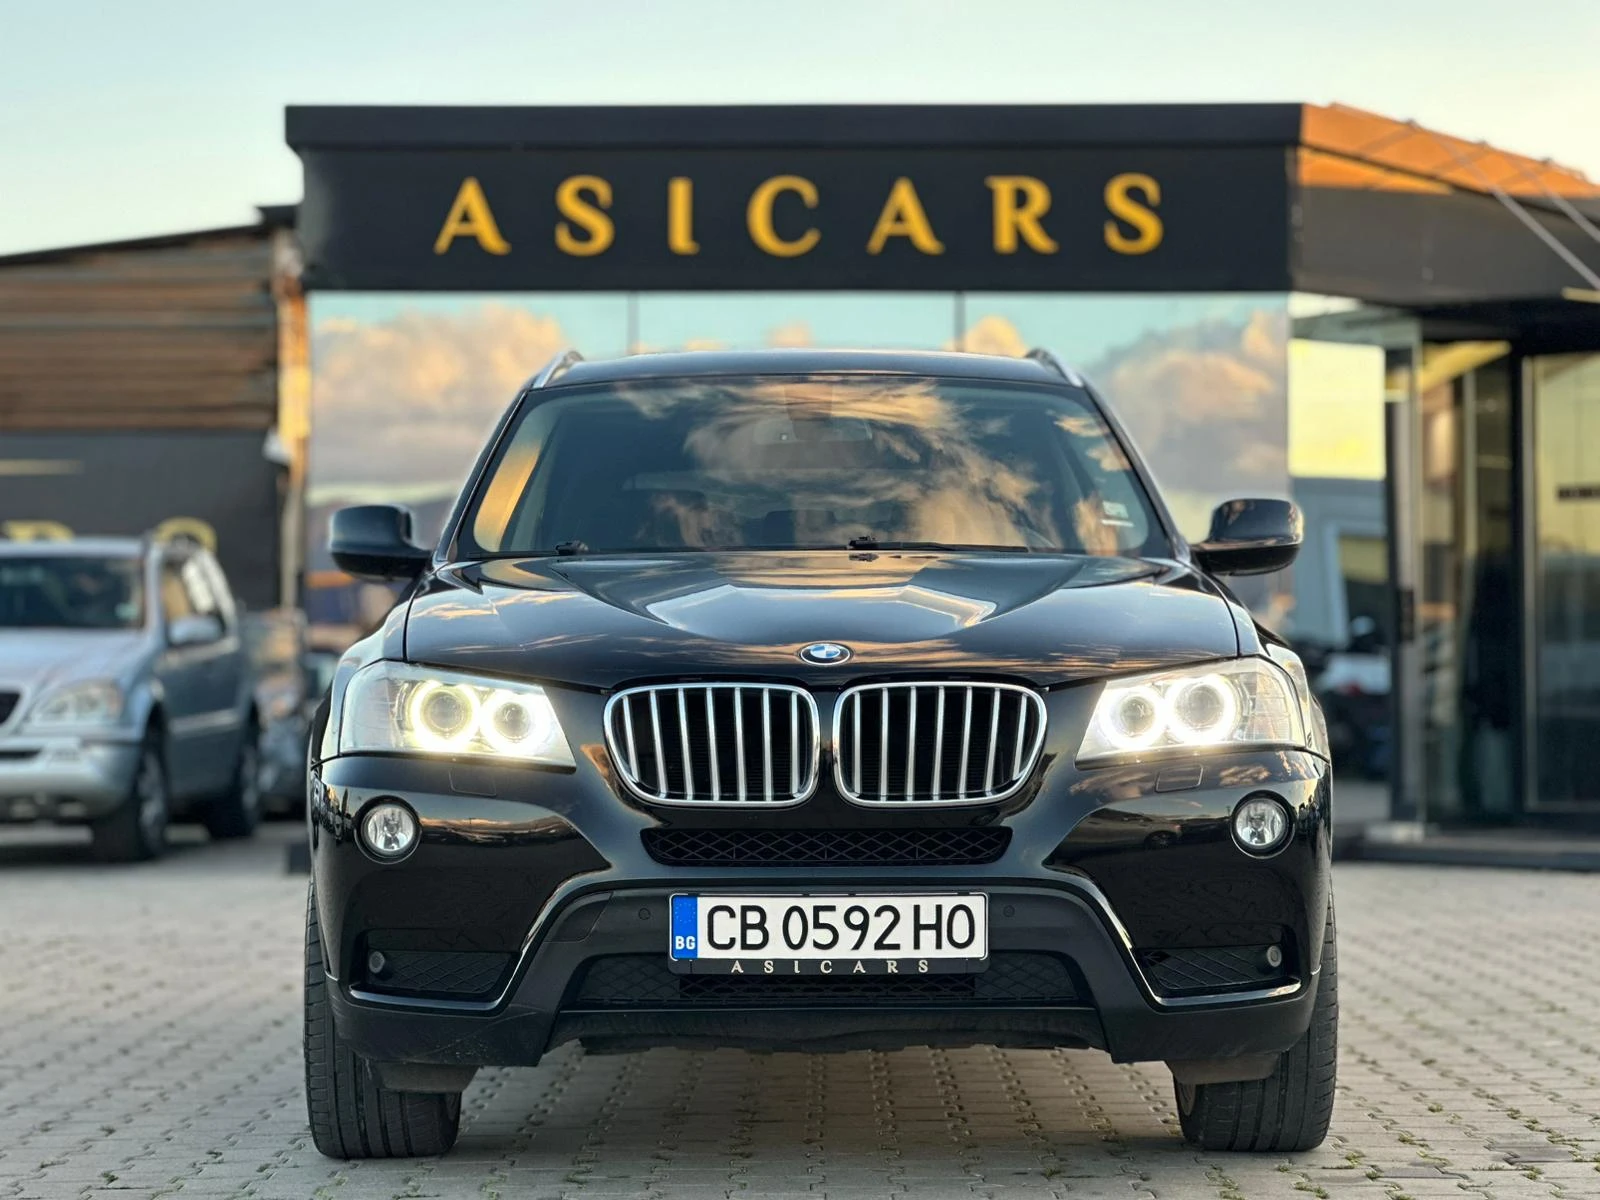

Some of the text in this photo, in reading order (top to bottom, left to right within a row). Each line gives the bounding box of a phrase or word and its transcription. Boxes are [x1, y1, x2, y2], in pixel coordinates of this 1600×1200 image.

[433, 174, 1164, 257] ASICARS
[675, 935, 696, 950] BG
[707, 904, 770, 951] CB
[782, 904, 901, 951] 0592
[730, 959, 929, 974] ASICARS
